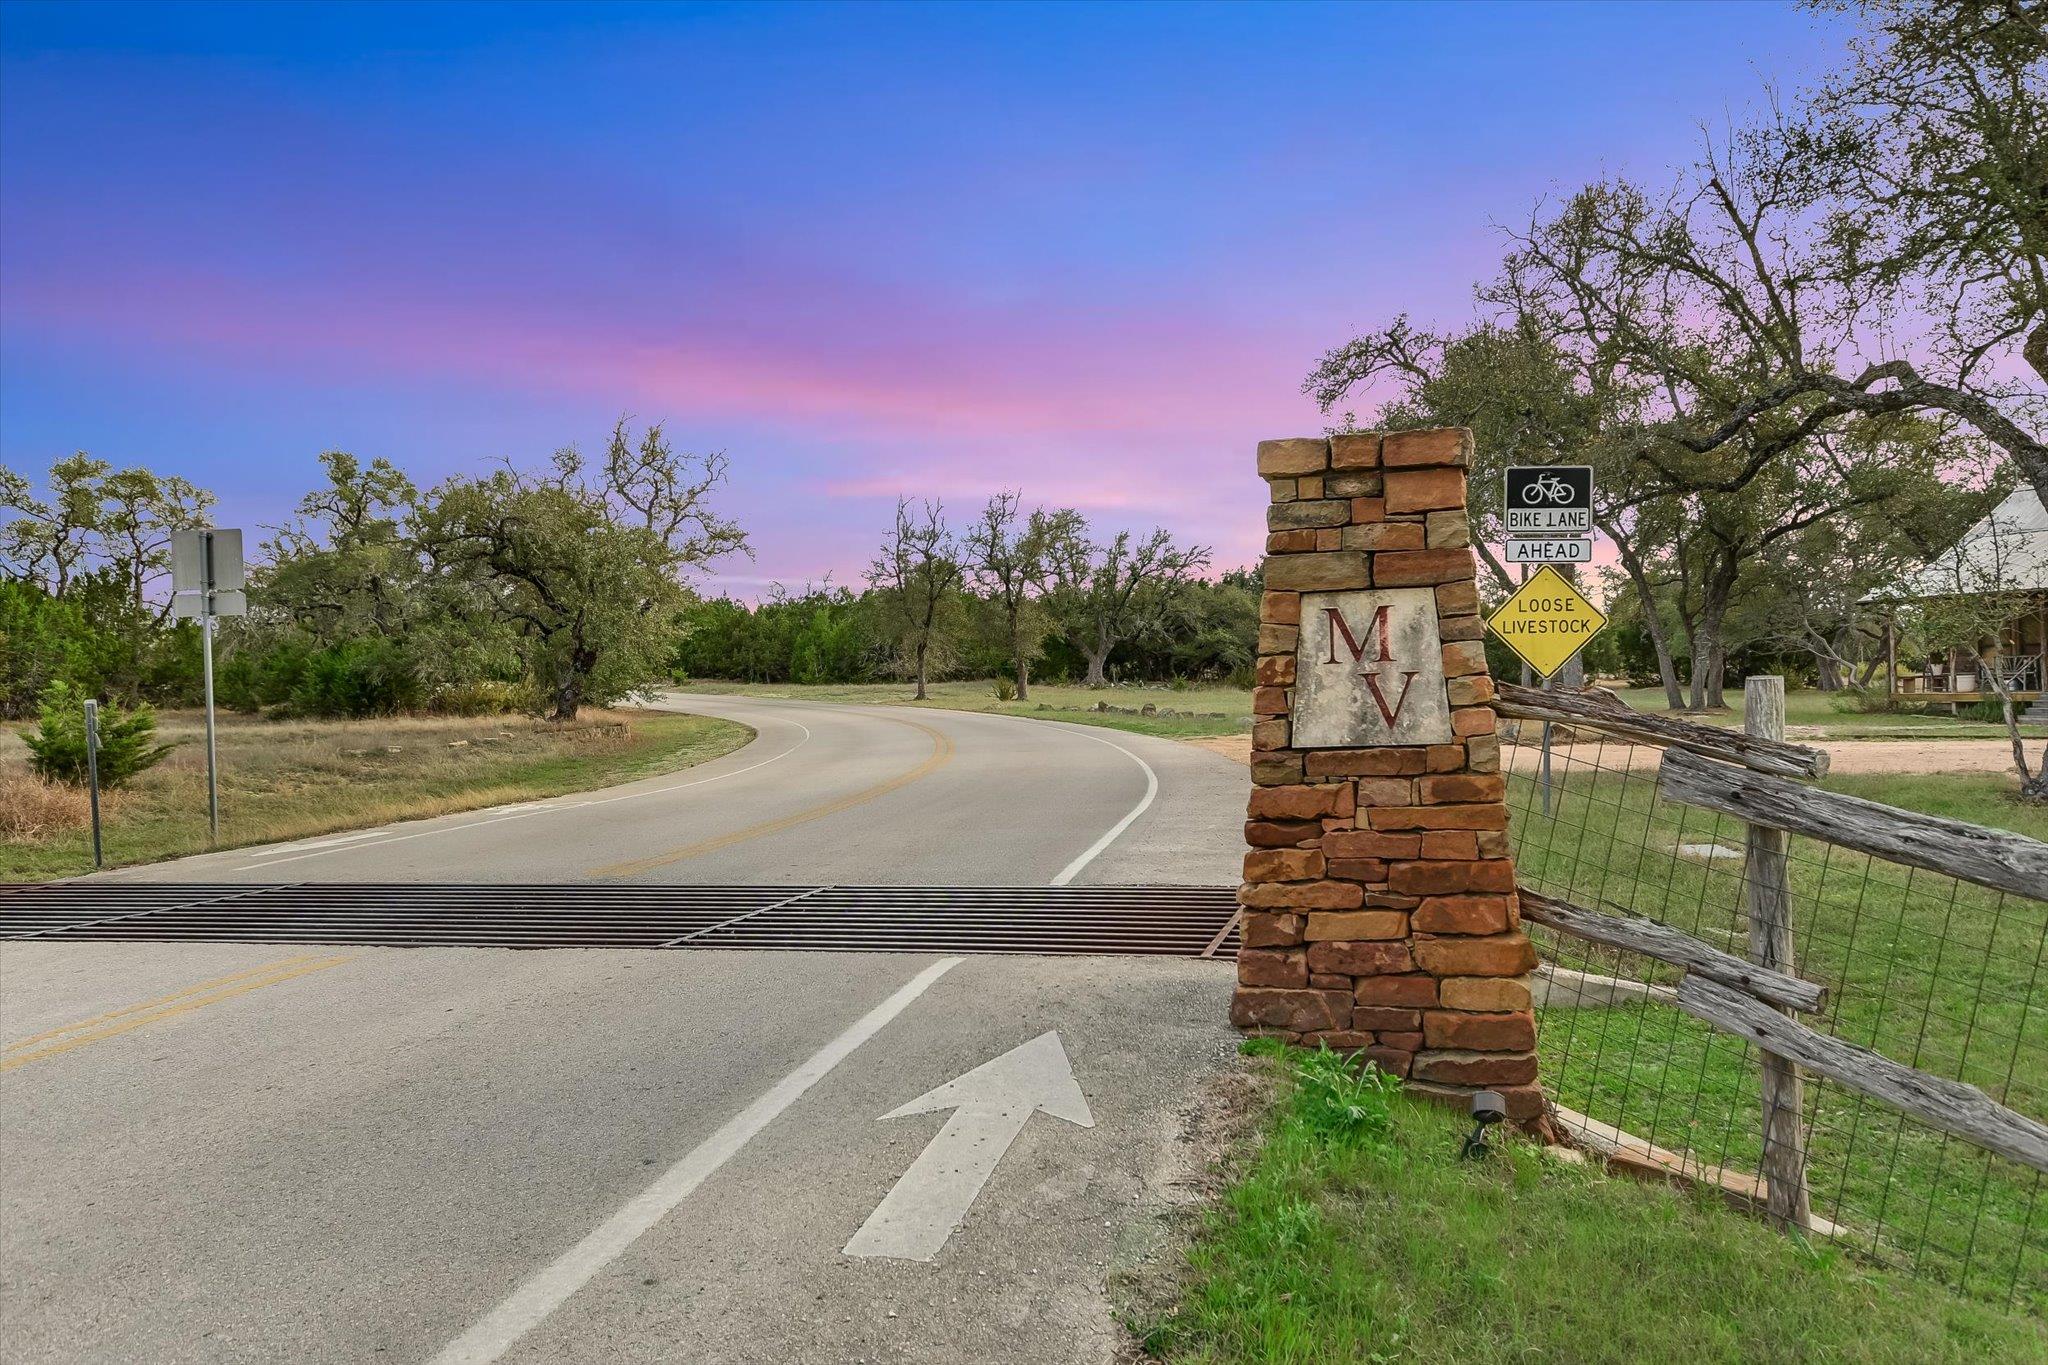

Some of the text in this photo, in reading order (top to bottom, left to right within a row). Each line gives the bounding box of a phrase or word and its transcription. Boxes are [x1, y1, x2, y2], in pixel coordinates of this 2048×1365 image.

[1509, 512, 1587, 527] BIKE LANE
[1517, 543, 1580, 559] AHEAD
[1518, 598, 1575, 613] LOOSE
[1502, 619, 1591, 635] LIVESTOCK
